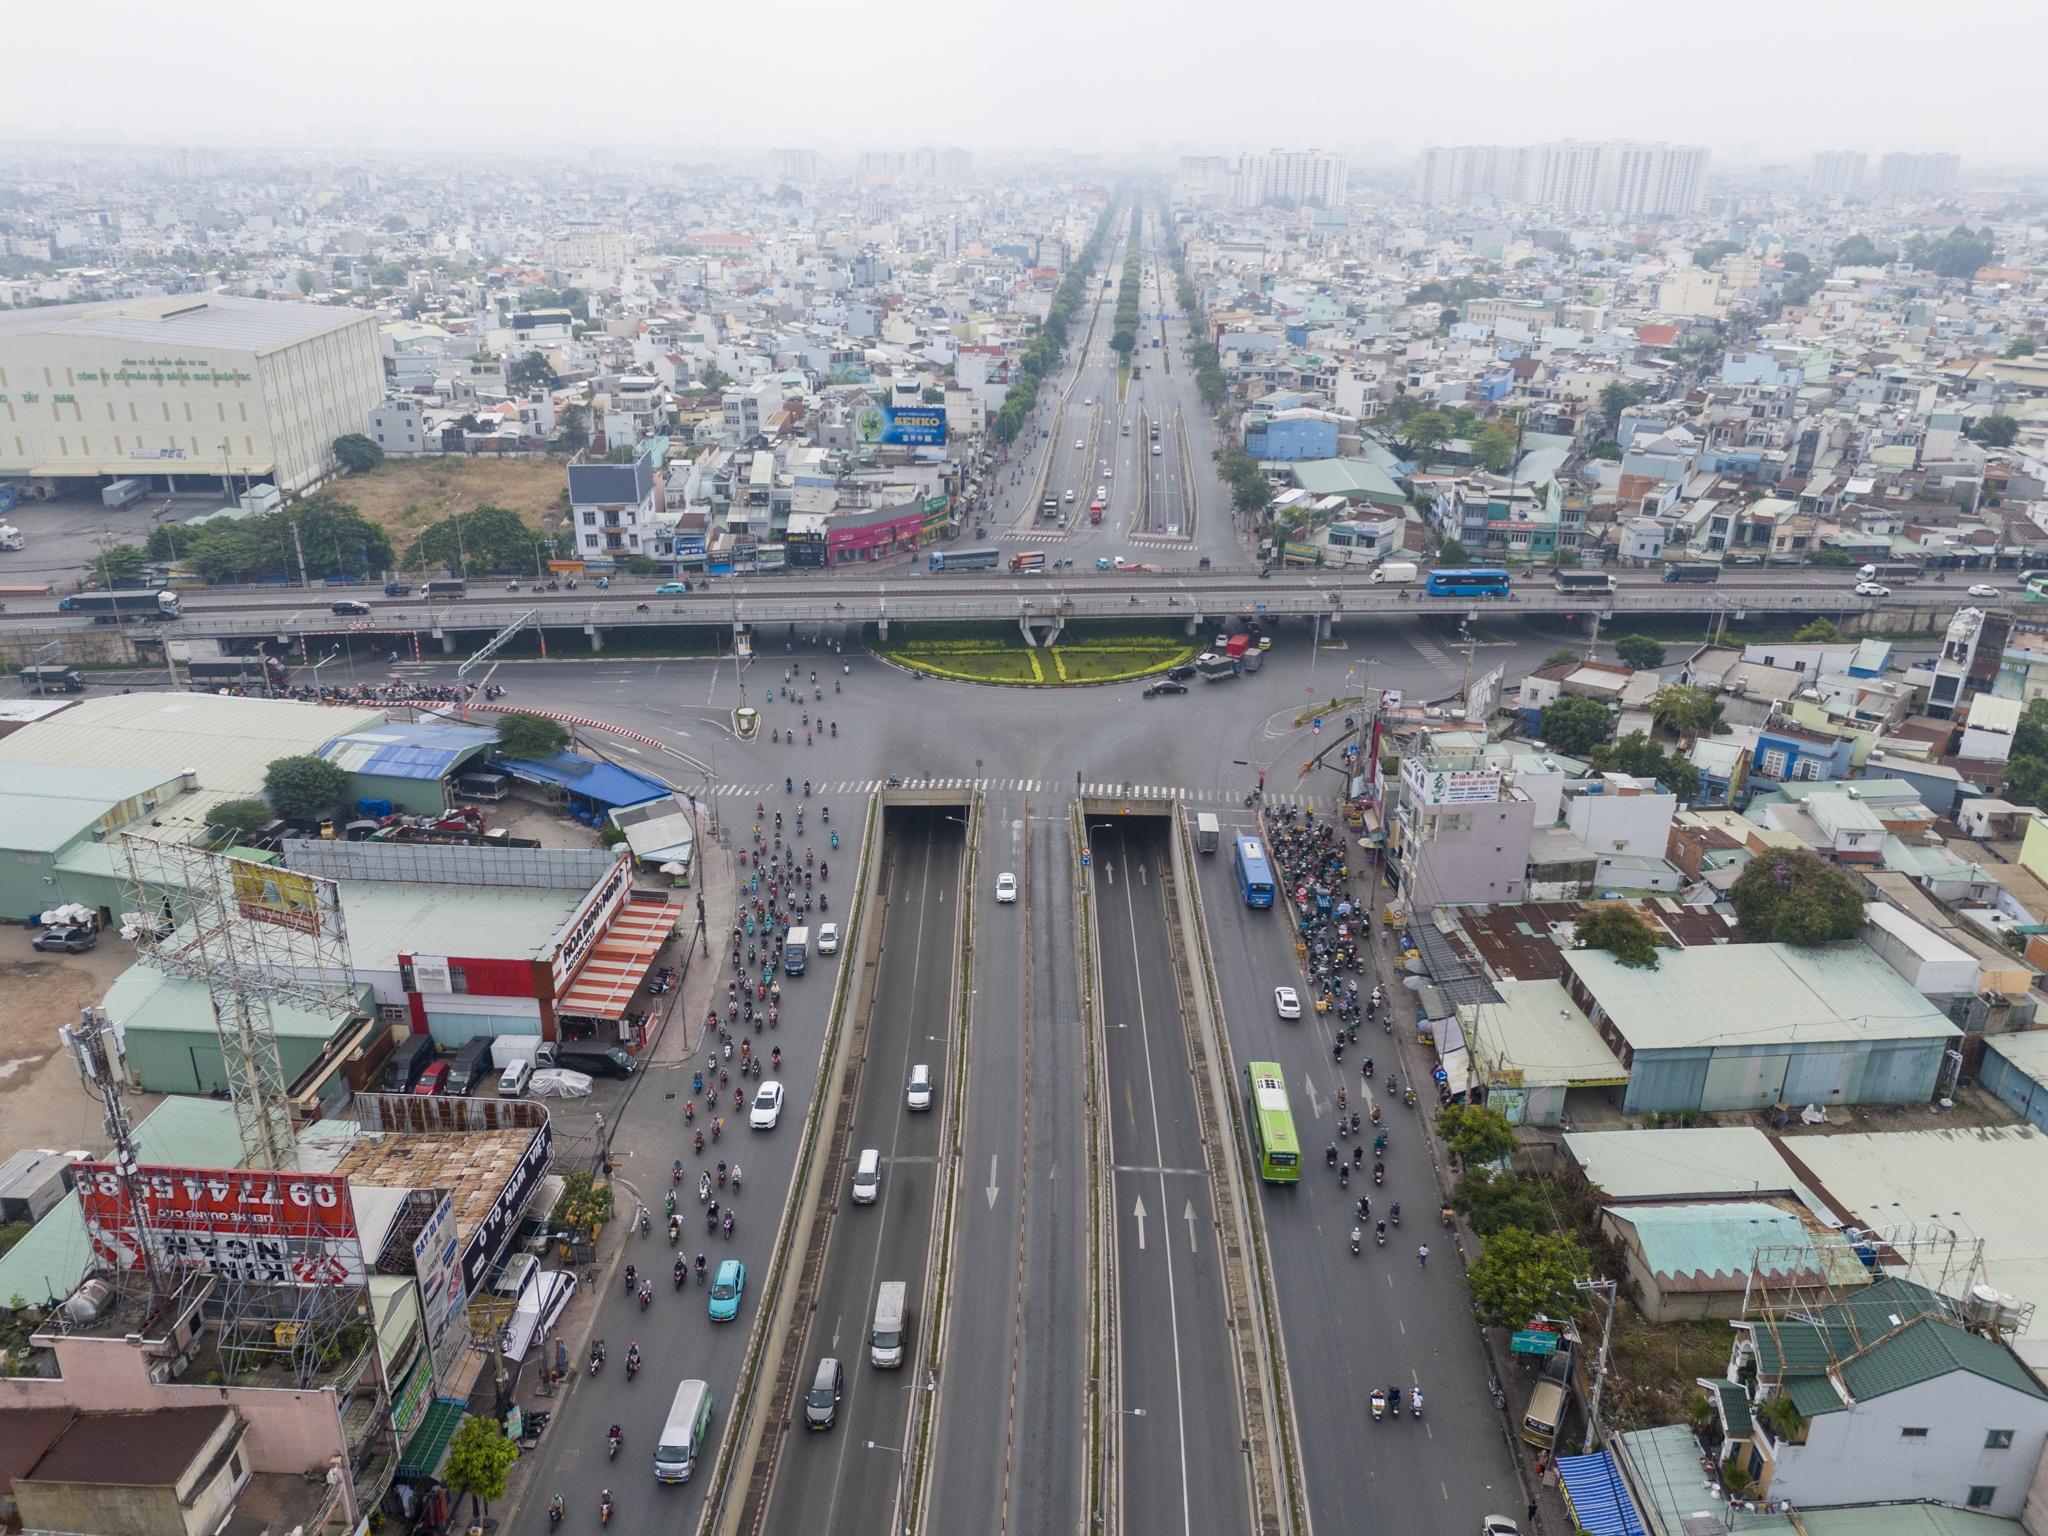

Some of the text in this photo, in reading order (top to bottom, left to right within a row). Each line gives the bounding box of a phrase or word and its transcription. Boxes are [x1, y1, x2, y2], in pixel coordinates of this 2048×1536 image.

[53, 394, 75, 403] NAM
[894, 416, 940, 427] SENKO
[565, 926, 596, 976] MOTORCYCLE
[505, 1167, 526, 1207] NAM
[529, 1132, 546, 1166] VIỆT
